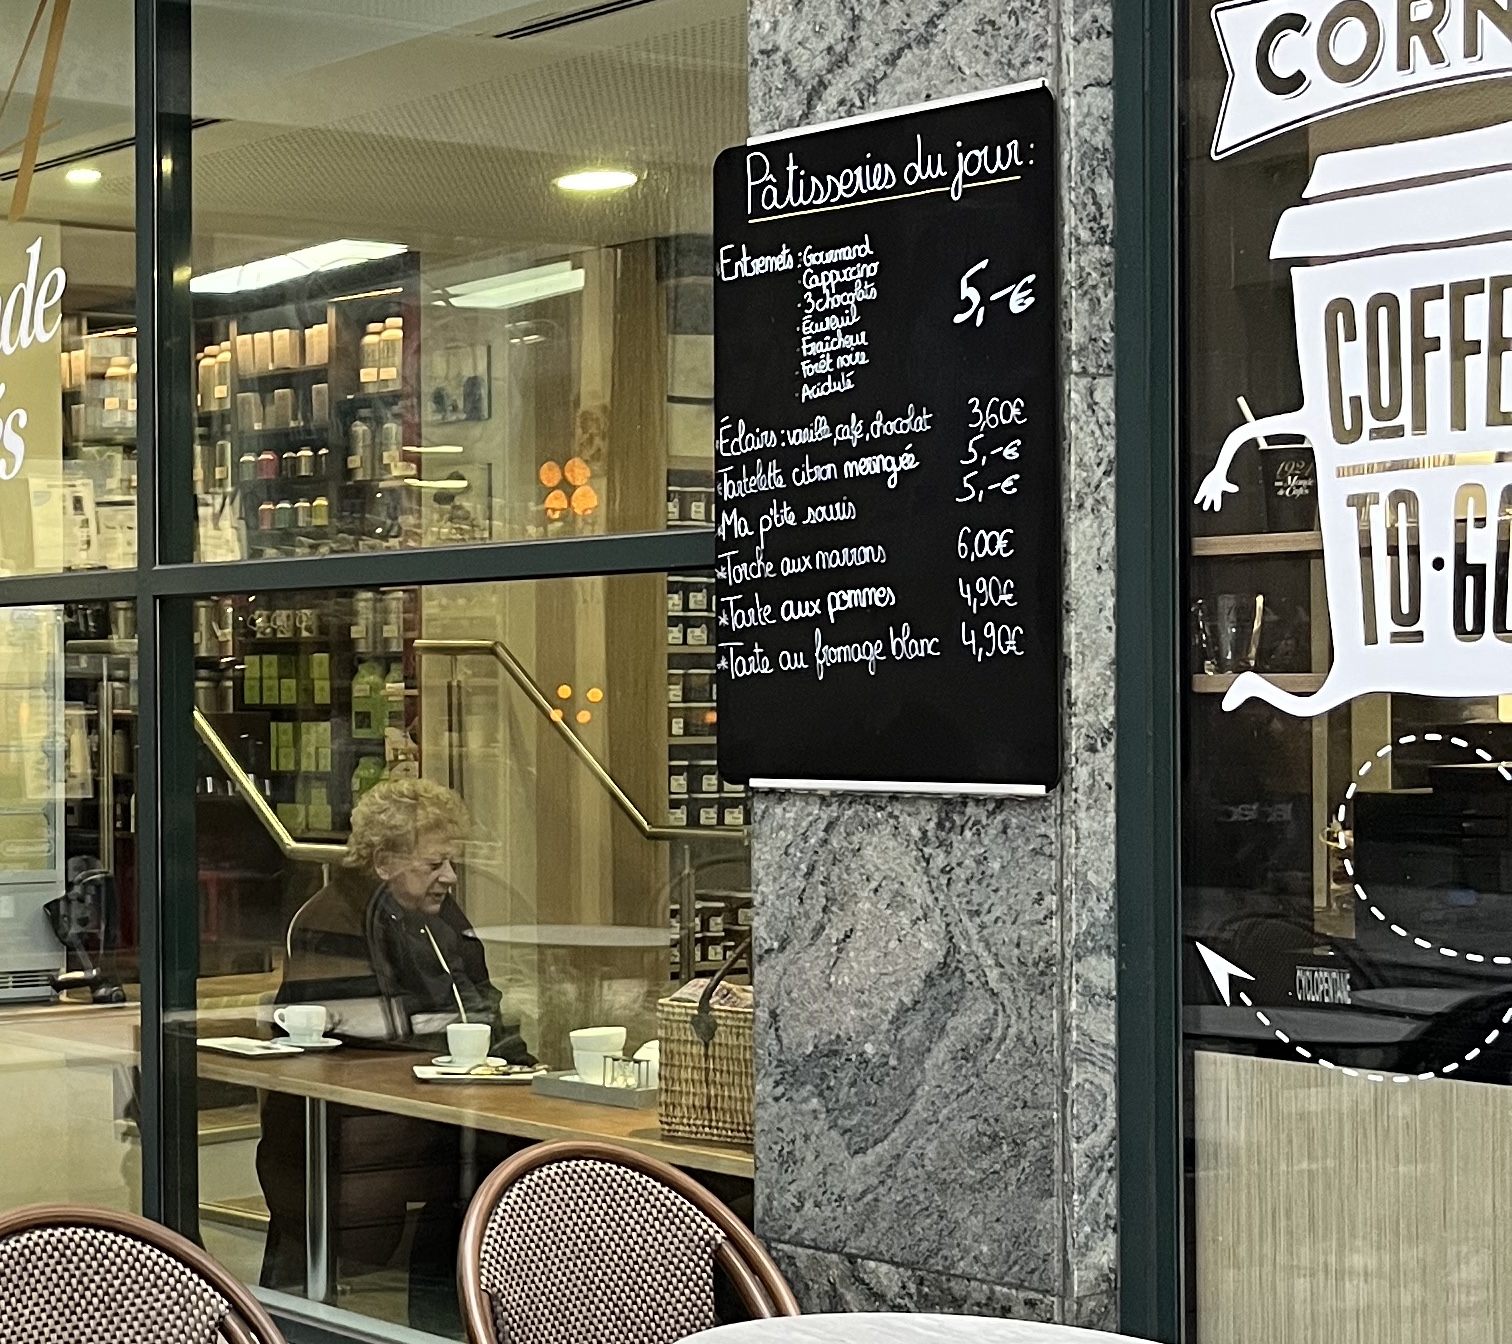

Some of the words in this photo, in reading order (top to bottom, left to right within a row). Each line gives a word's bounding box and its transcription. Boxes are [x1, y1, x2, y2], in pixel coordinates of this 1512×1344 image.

[746, 150, 897, 215] Pâtisseries
[903, 133, 948, 186] du
[802, 233, 874, 268] Gourmand
[802, 260, 880, 294] Cappuccino
[836, 346, 870, 370] noire
[801, 370, 856, 404] Acidulé
[870, 403, 934, 438] chocolat
[967, 396, 1028, 432] 3,60€
[791, 453, 839, 487] citron
[721, 507, 755, 542] Ma
[801, 495, 857, 525] souris
[718, 544, 777, 587] Torche
[780, 554, 813, 577] aux
[815, 544, 887, 571] marrons
[957, 525, 1015, 563] 6,00€
[720, 592, 777, 633] Tarte
[780, 598, 822, 622] aux
[826, 585, 897, 624] pommes
[958, 575, 1019, 615] 4,90€
[717, 640, 775, 681] Tarte
[778, 649, 809, 672] au
[813, 626, 888, 681] fromage
[888, 621, 942, 661] blanc
[961, 620, 1025, 663] 4,90€
